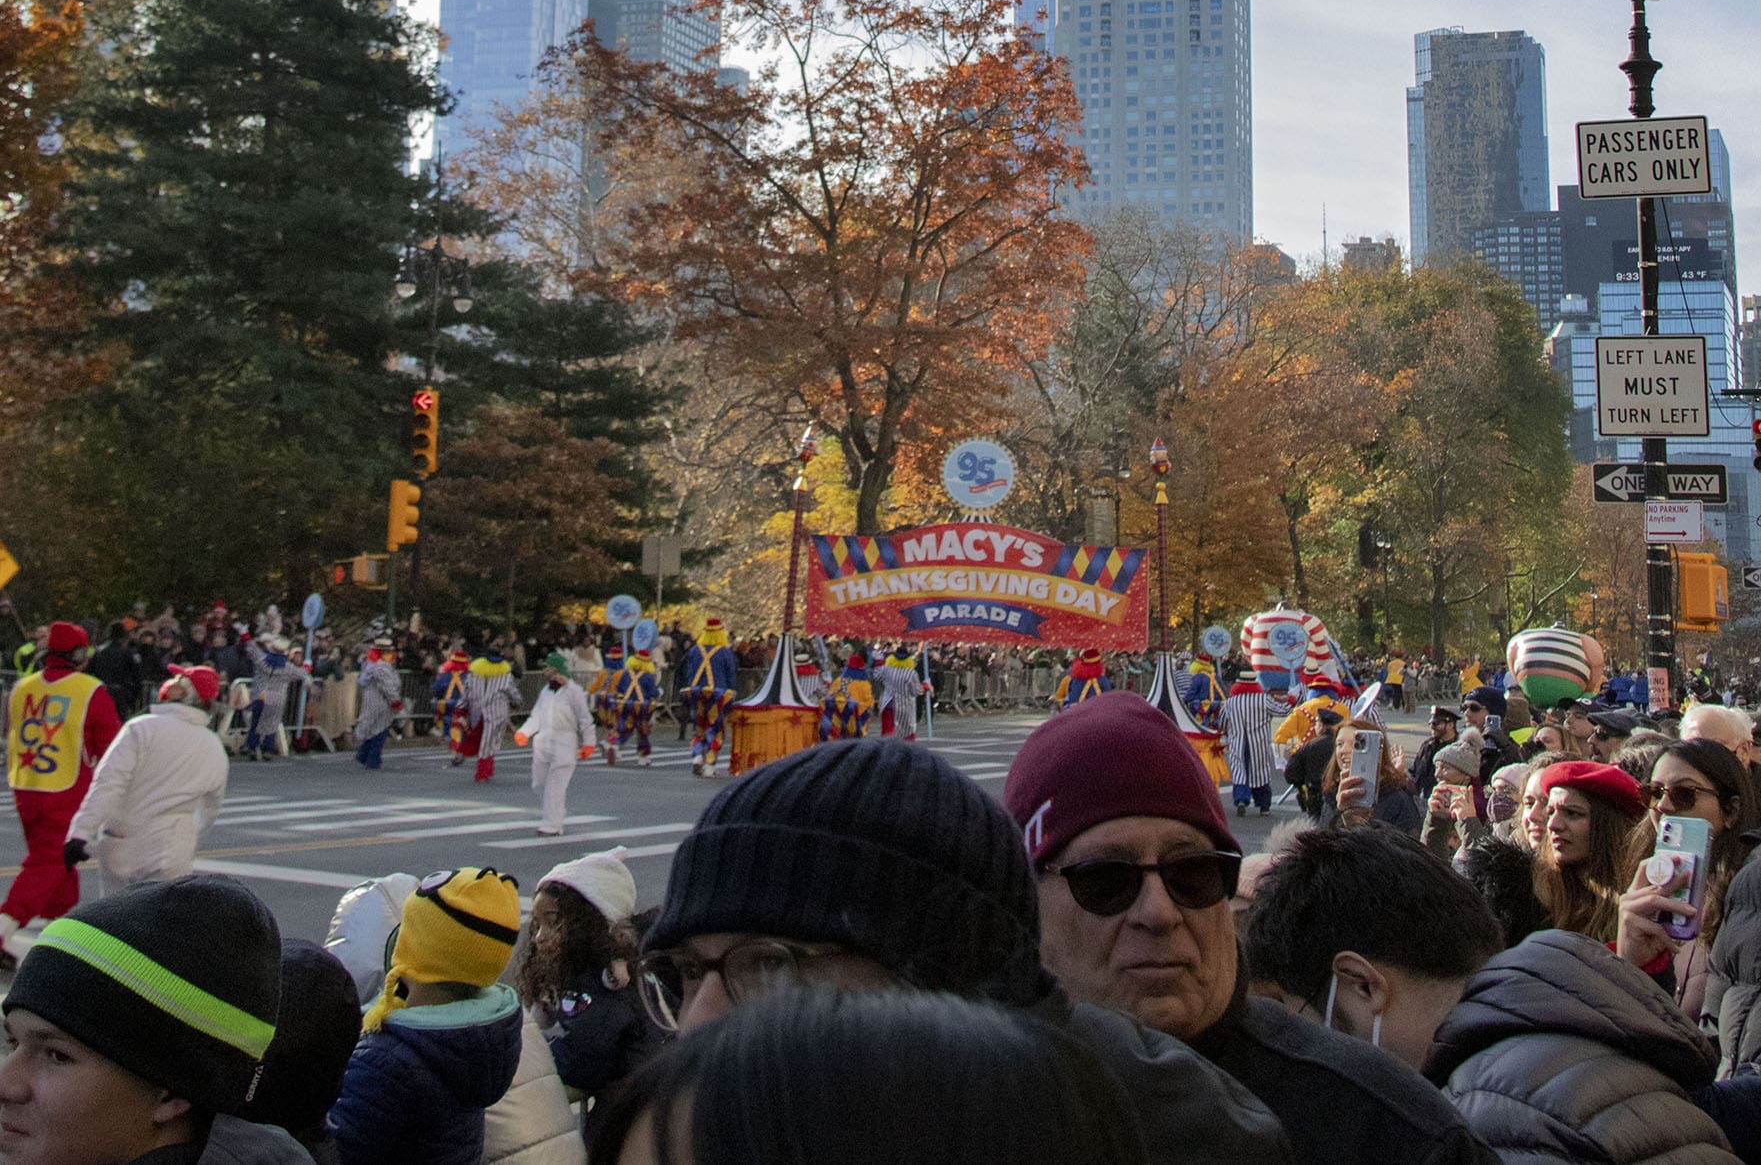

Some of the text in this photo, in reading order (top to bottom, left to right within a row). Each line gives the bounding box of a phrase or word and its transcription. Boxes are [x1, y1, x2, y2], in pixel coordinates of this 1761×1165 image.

[1586, 128, 1699, 154] PASSENGER
[1588, 157, 1700, 184] CARS ONLY
[1681, 271, 1694, 279] 43
[1606, 349, 1697, 364] LEFT LANE
[1625, 377, 1679, 395] MUST
[1608, 408, 1699, 423] TURN LEFT
[957, 452, 997, 484] 95
[1611, 475, 1714, 491] ONE WAY
[1648, 505, 1689, 513] NO PARKING
[902, 529, 1045, 568] MACY'S
[830, 570, 1120, 616] THANKSGIVING DAY
[925, 605, 1021, 628] PARADE
[1208, 633, 1225, 646] 95
[1275, 629, 1297, 647] 95
